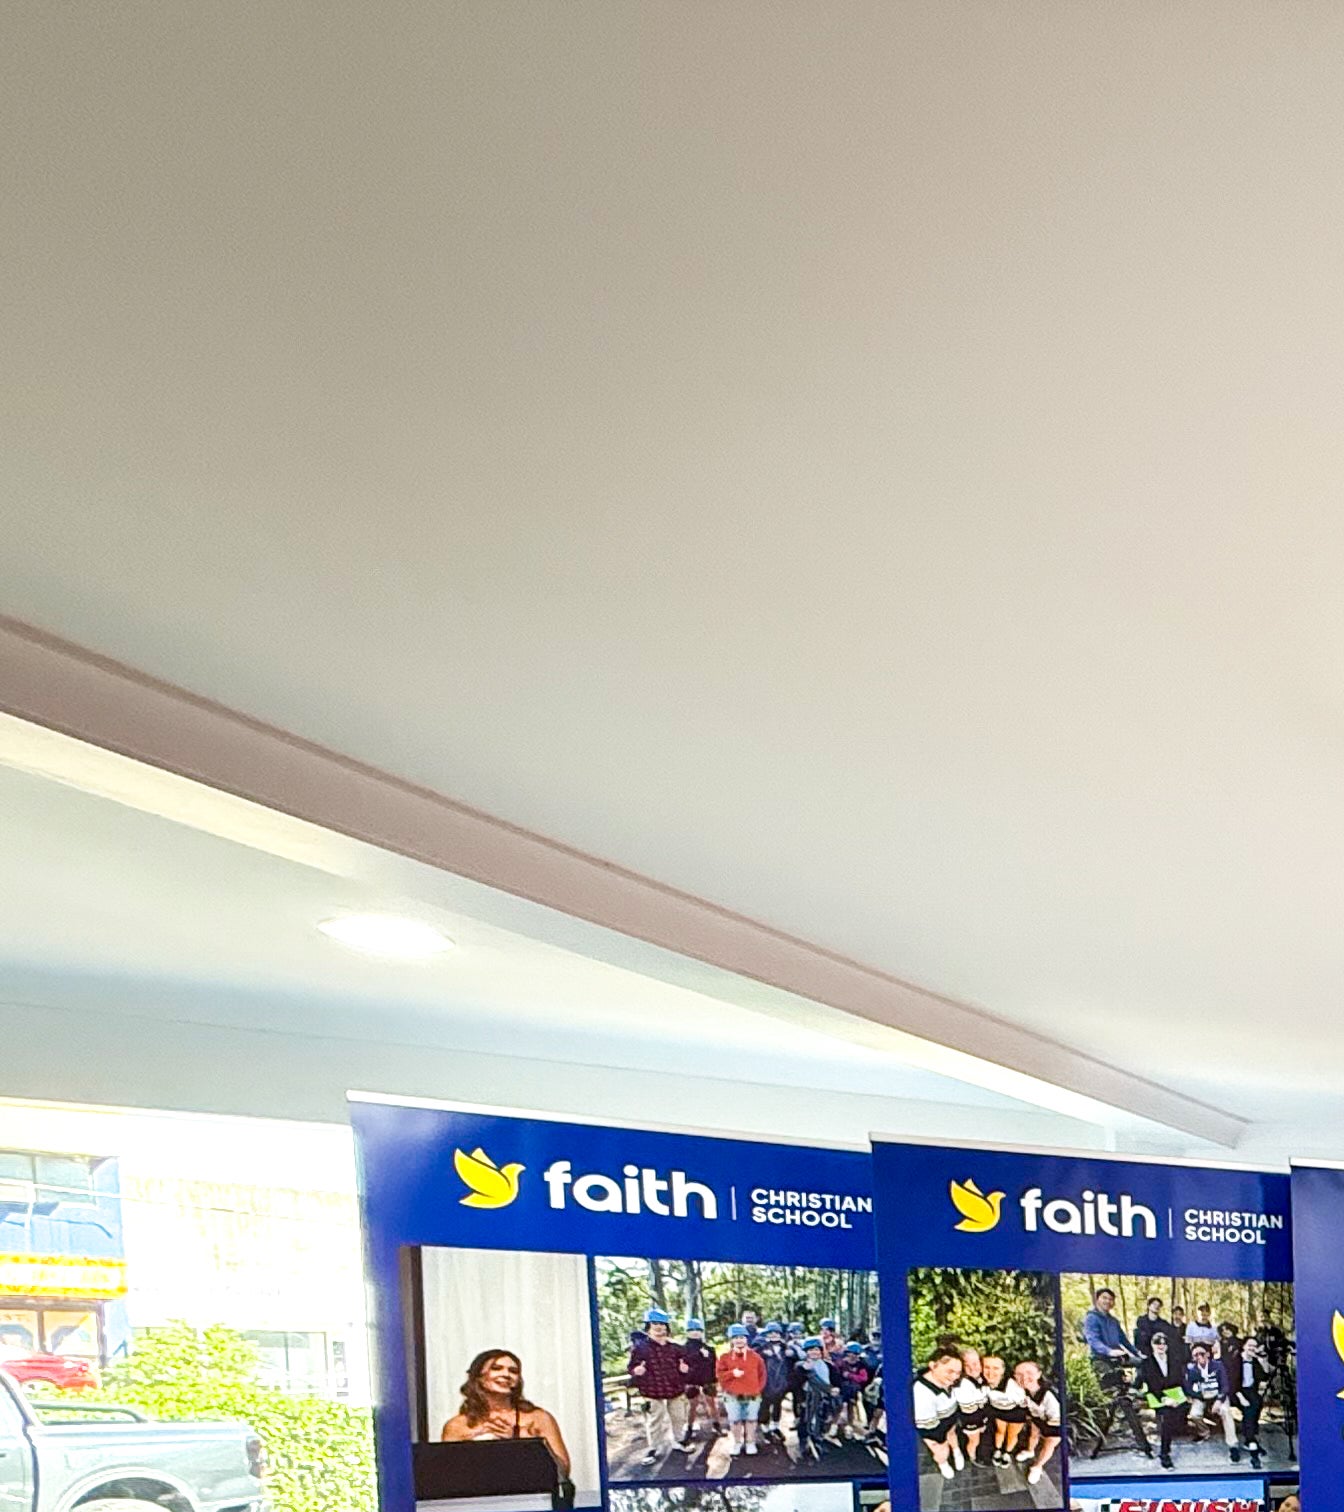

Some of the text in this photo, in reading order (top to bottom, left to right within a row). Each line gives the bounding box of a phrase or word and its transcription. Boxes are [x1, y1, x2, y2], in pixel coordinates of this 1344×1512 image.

[544, 1160, 718, 1219] faith
[750, 1187, 873, 1214] CHRISTIAN
[752, 1205, 853, 1229] SCHOOL
[1020, 1188, 1157, 1238] faith
[1184, 1208, 1283, 1230] CHRISTIAN
[1184, 1225, 1267, 1244] SCHOOL
